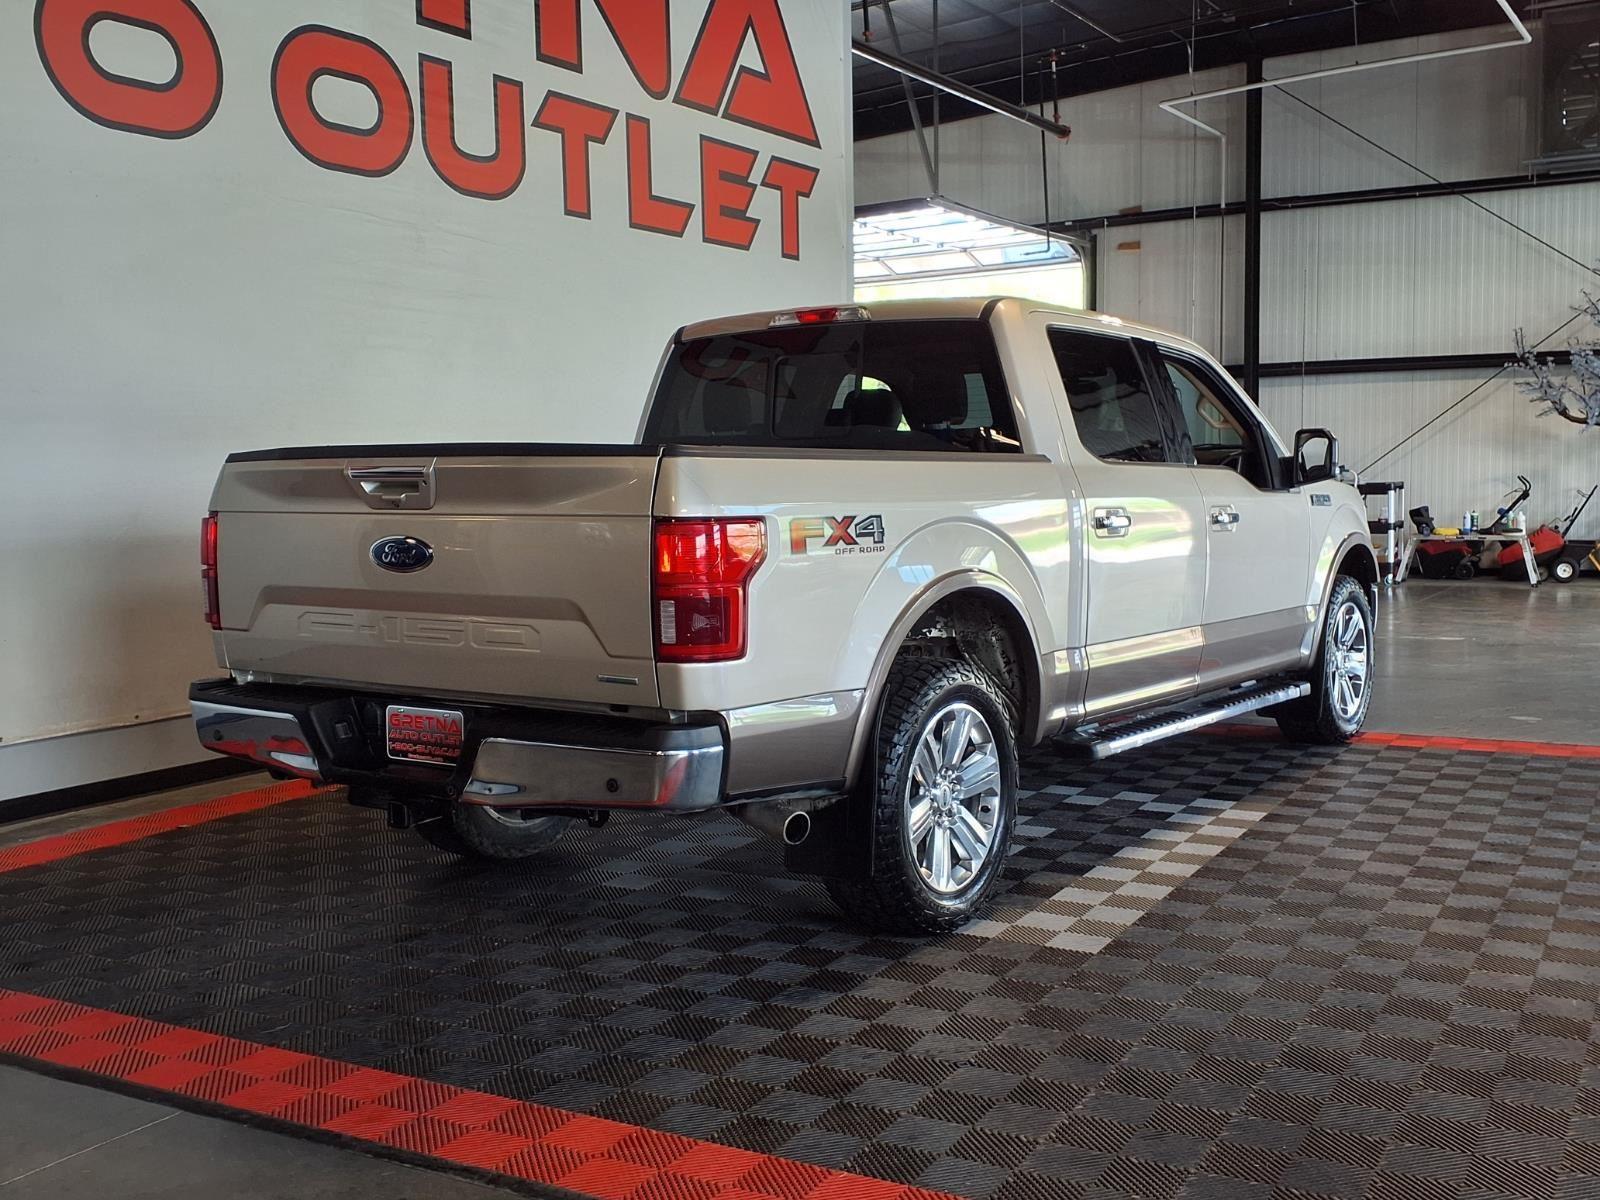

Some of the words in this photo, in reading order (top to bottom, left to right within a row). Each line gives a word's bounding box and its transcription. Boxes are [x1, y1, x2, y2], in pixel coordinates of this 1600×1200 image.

[271, 24, 820, 261] OUTLET
[790, 514, 885, 554] FX4
[382, 543, 417, 564] Ford
[835, 547, 856, 555] OFF
[859, 545, 885, 553] ROAD
[298, 611, 541, 652] F-150
[389, 713, 460, 734] GRETNA
[389, 729, 418, 740] AUTO
[420, 732, 461, 746] OUTLET
